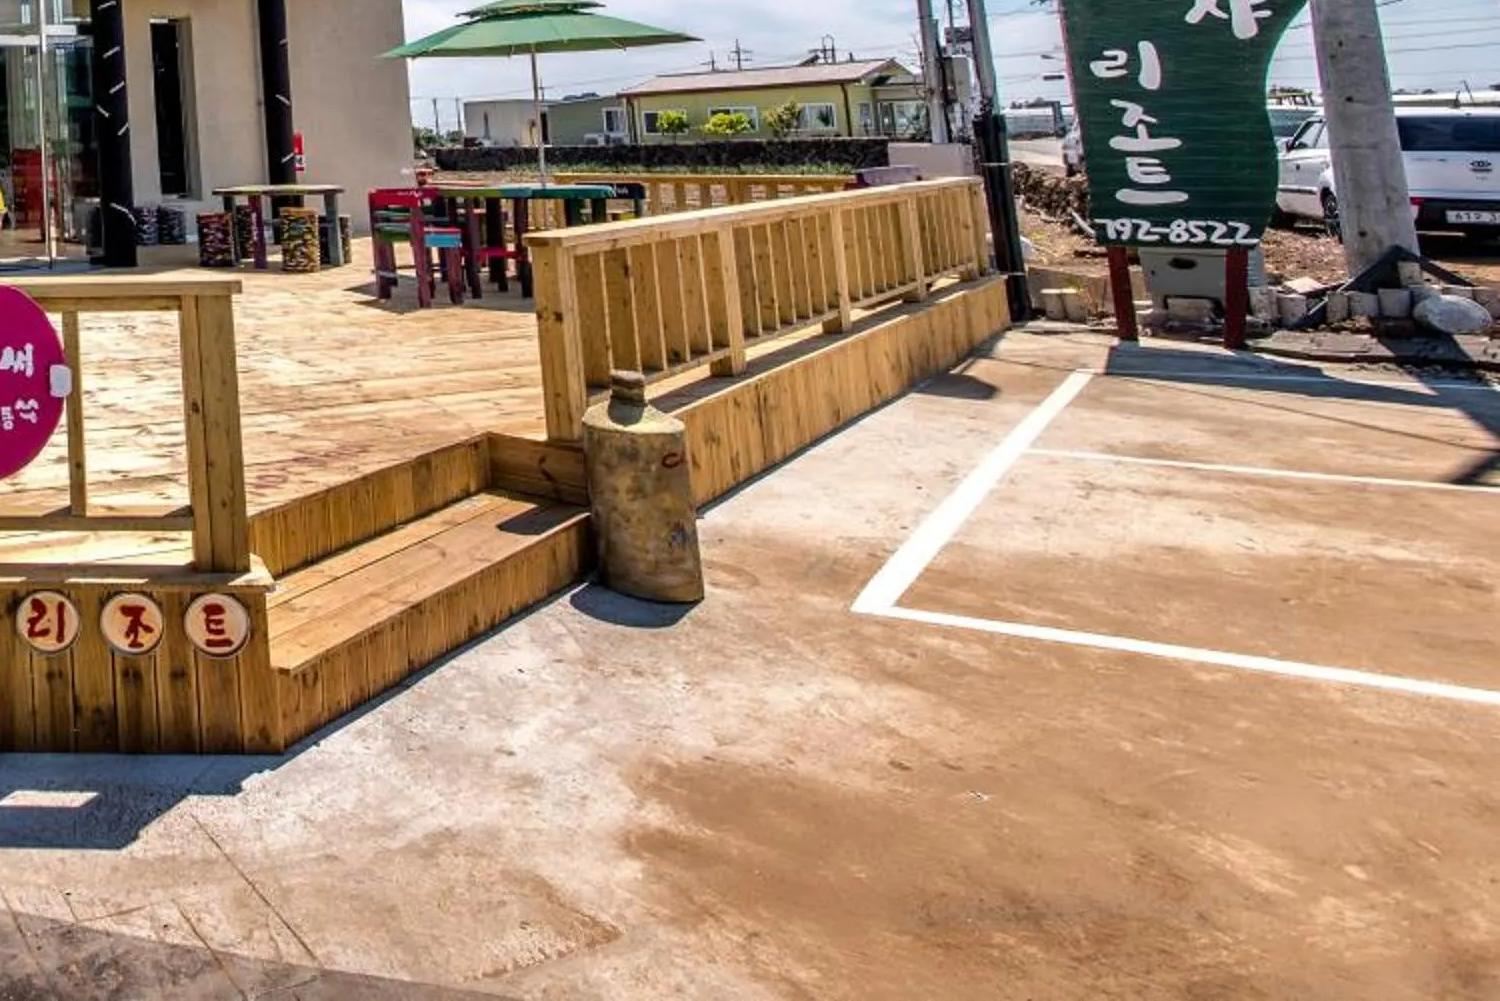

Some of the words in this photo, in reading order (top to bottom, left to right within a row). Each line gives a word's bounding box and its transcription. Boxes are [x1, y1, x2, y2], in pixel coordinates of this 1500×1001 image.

[1089, 39, 1190, 205] 리조트
[1094, 216, 1260, 245] 792-8522
[26, 598, 234, 648] 리조트
